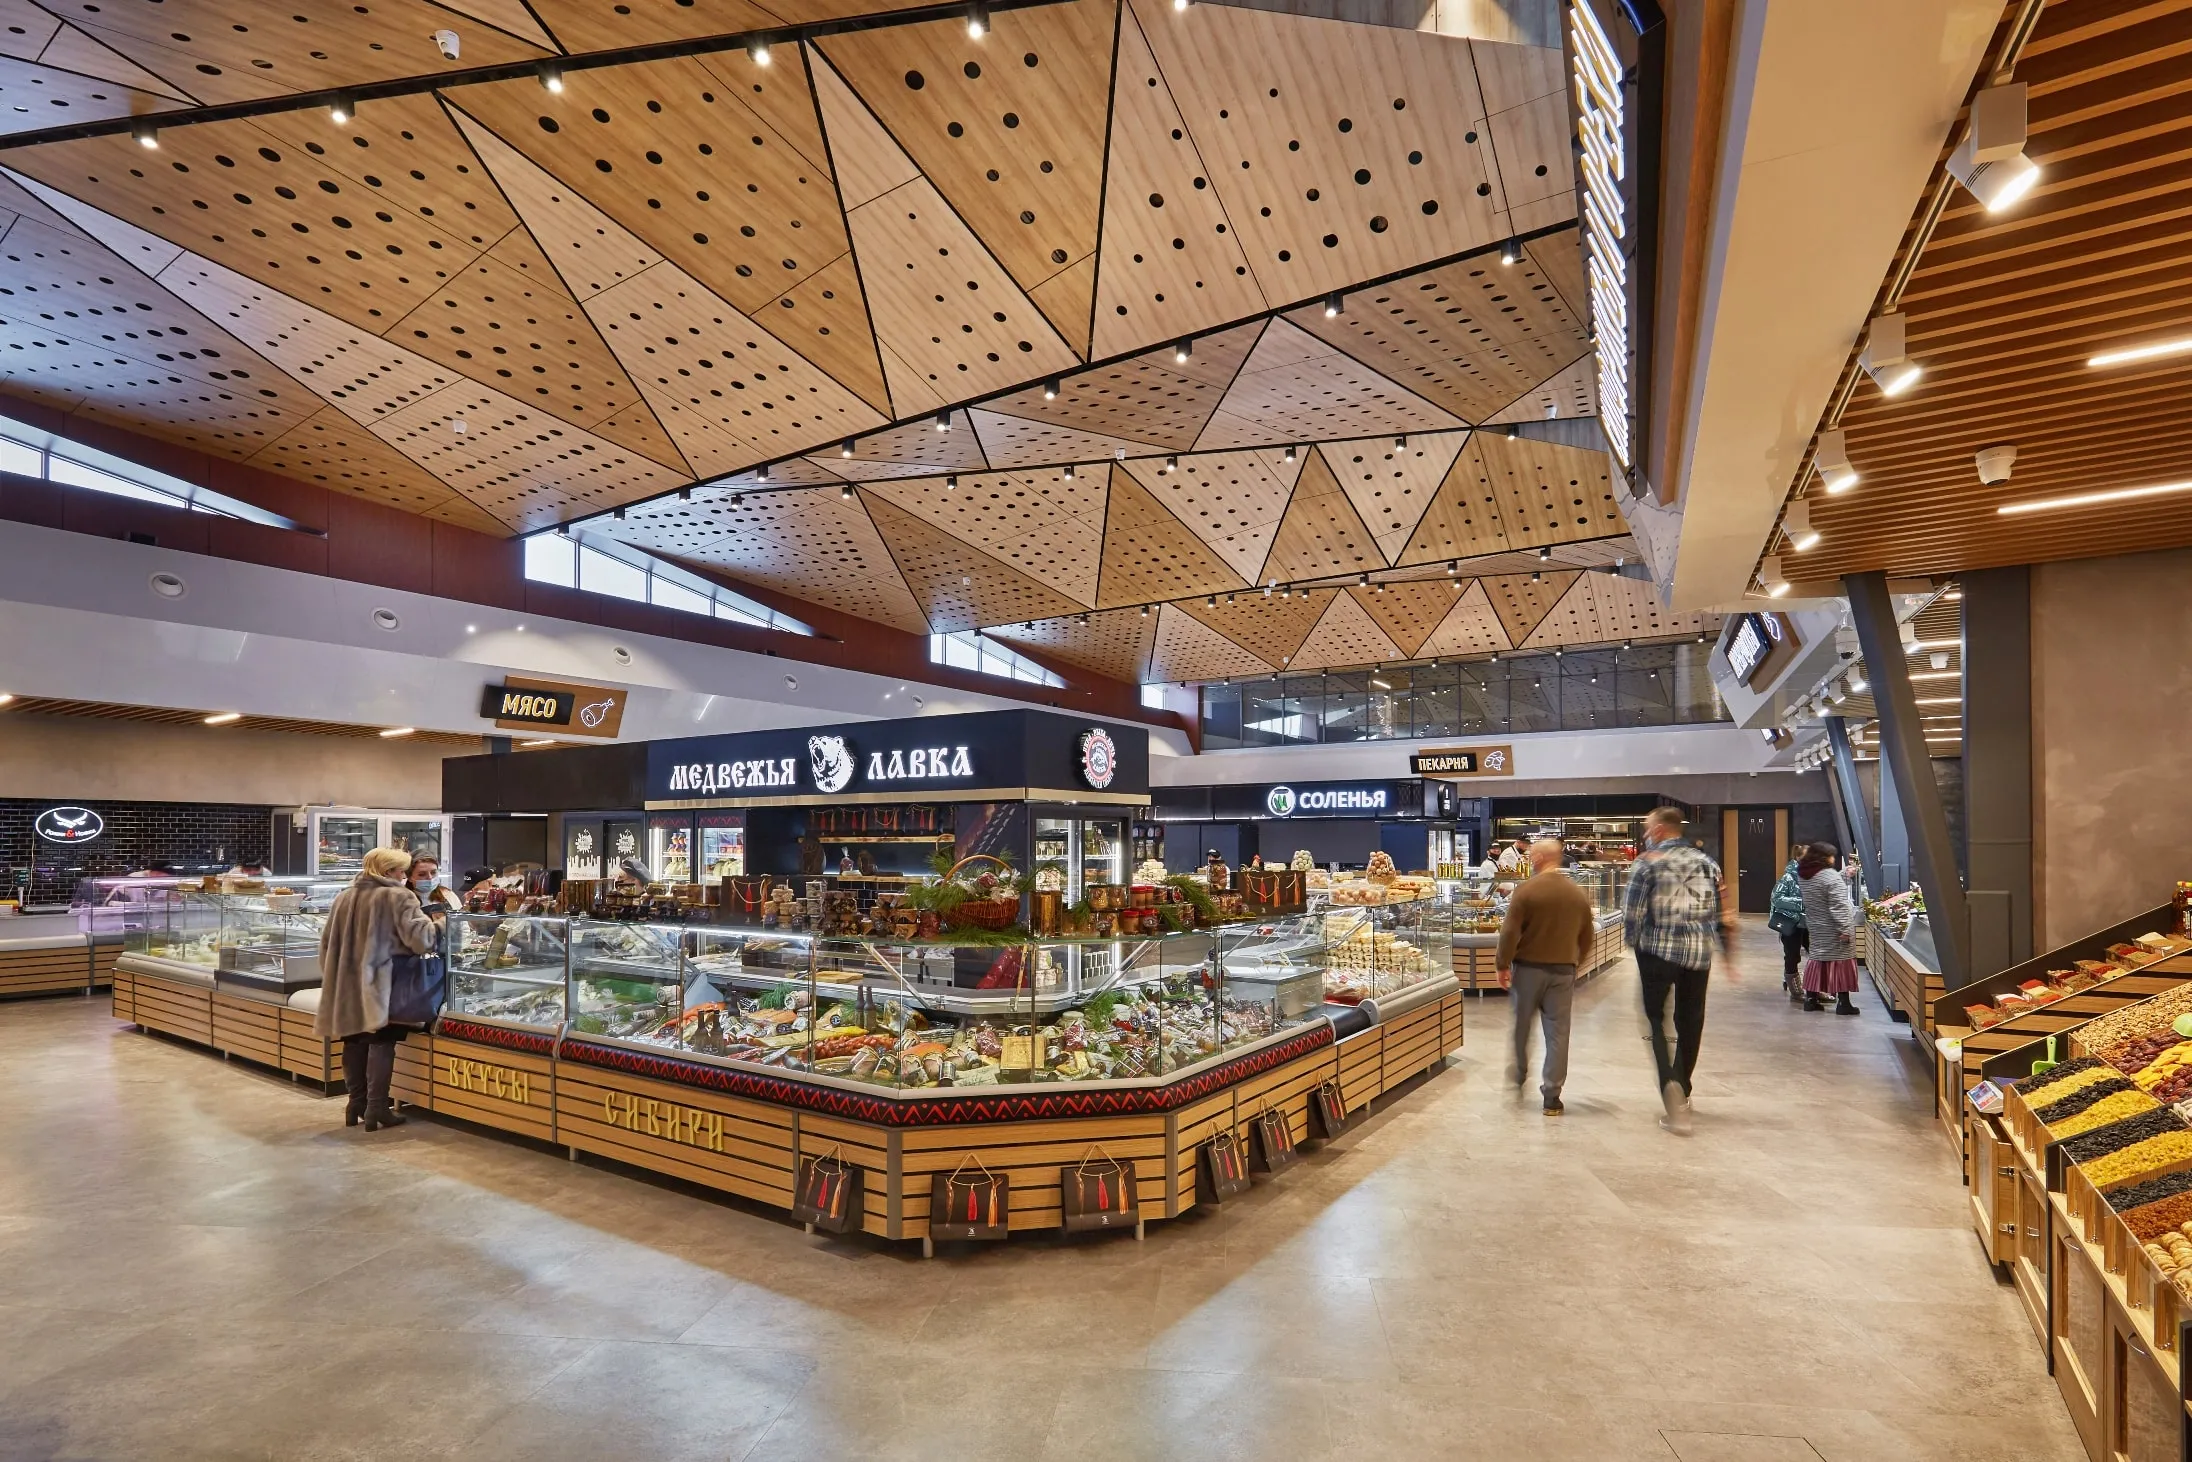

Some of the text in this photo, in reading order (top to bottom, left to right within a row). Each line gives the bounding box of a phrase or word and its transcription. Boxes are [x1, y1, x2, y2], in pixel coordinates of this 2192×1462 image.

[501, 693, 557, 718] МЯСО
[669, 746, 974, 795] МЕДВЕЖЬЯ ЛАВКА
[1418, 756, 1469, 771] ПЕКАРНЯ
[1300, 790, 1386, 809] СОЛЕНЬЯ
[449, 1057, 725, 1153] ВКУСЫ СИБИРИ
